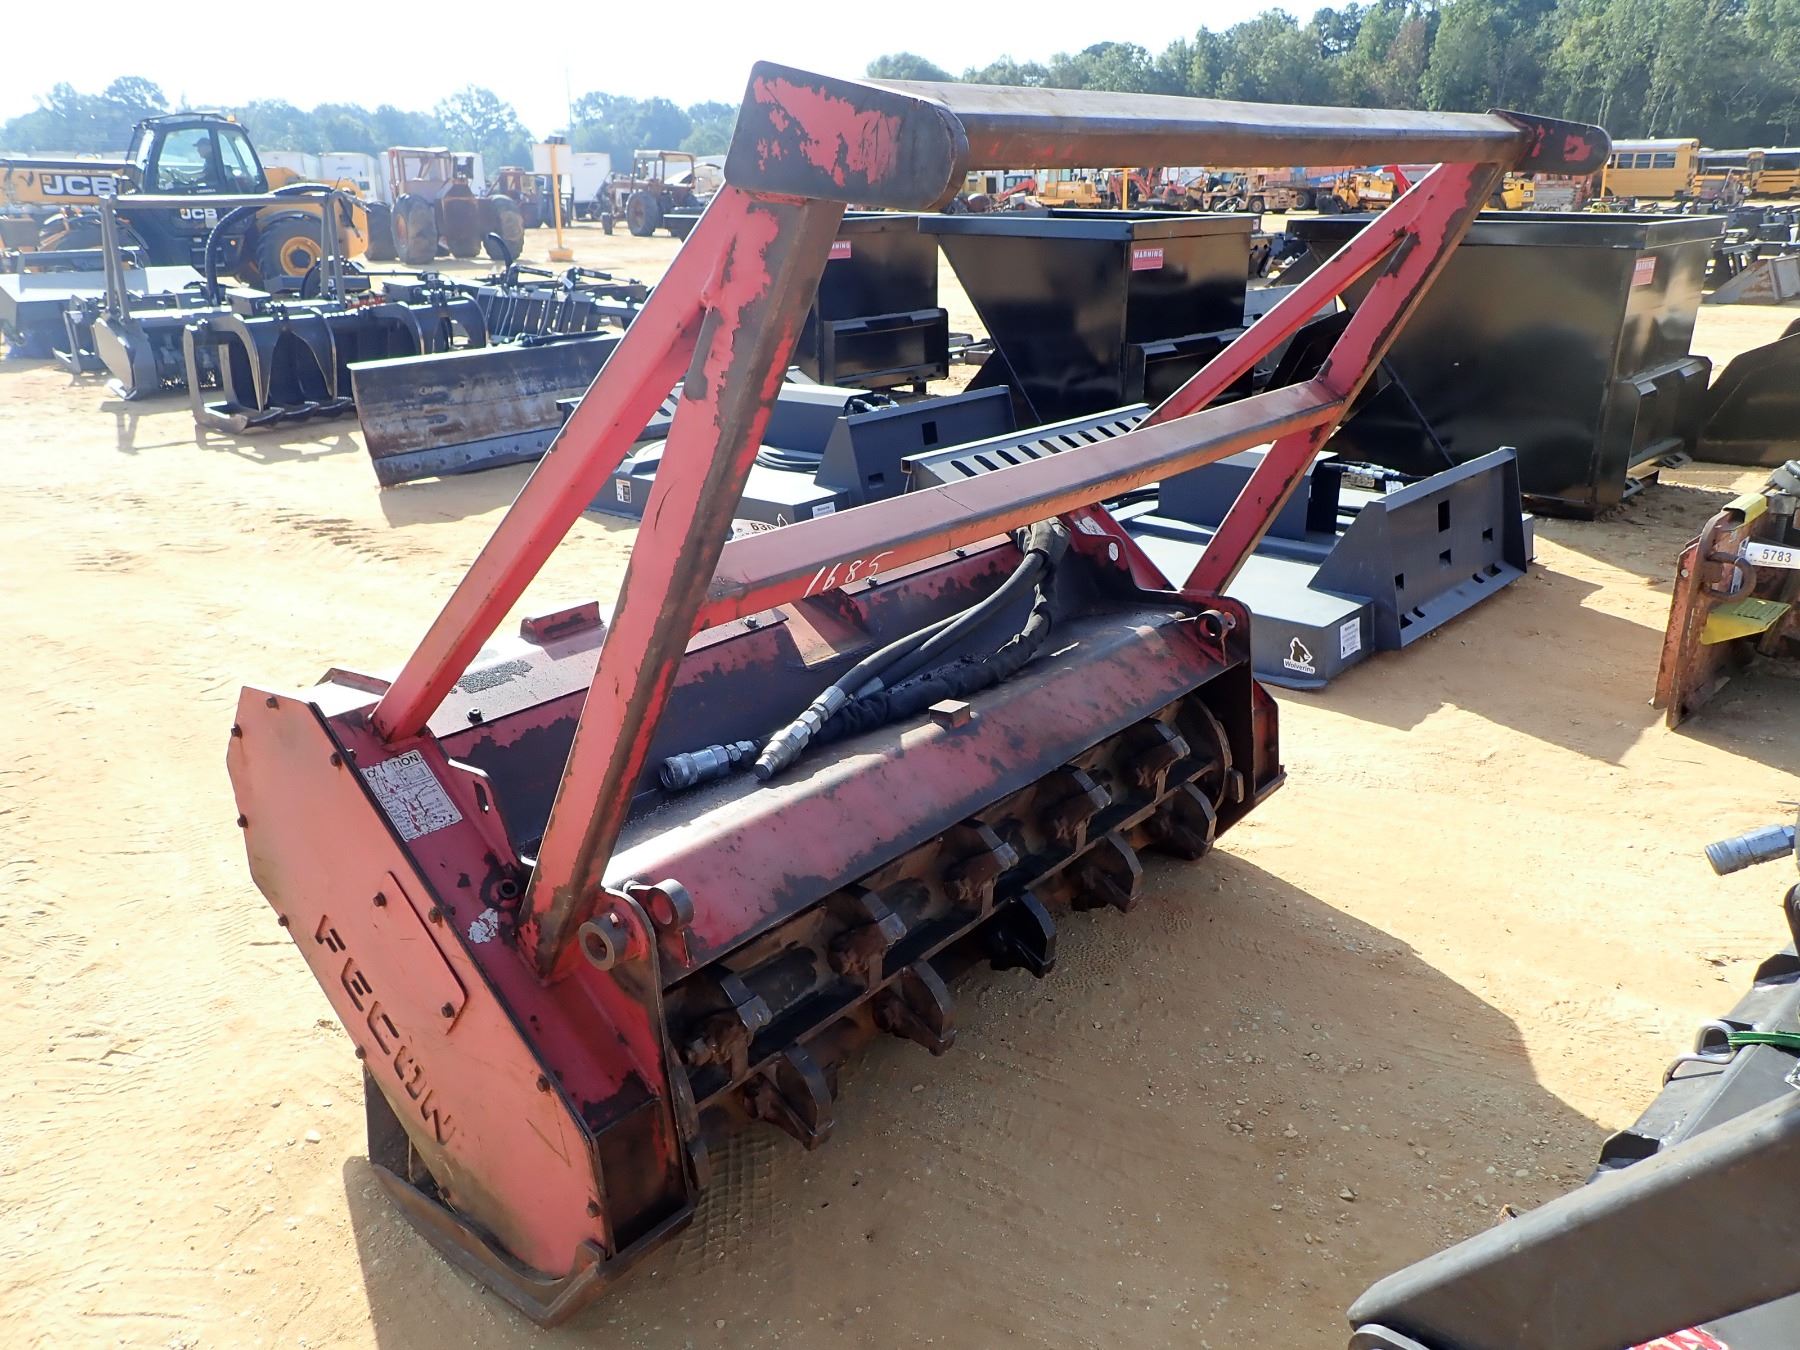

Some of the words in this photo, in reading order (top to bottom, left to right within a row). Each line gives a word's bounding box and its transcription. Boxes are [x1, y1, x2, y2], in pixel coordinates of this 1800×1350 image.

[42, 175, 117, 196] JCB
[180, 207, 217, 220] JCB
[1134, 249, 1163, 259] WARNING
[1762, 548, 1792, 563] 5783
[803, 551, 895, 599] 1685
[314, 914, 457, 1147] FECON
